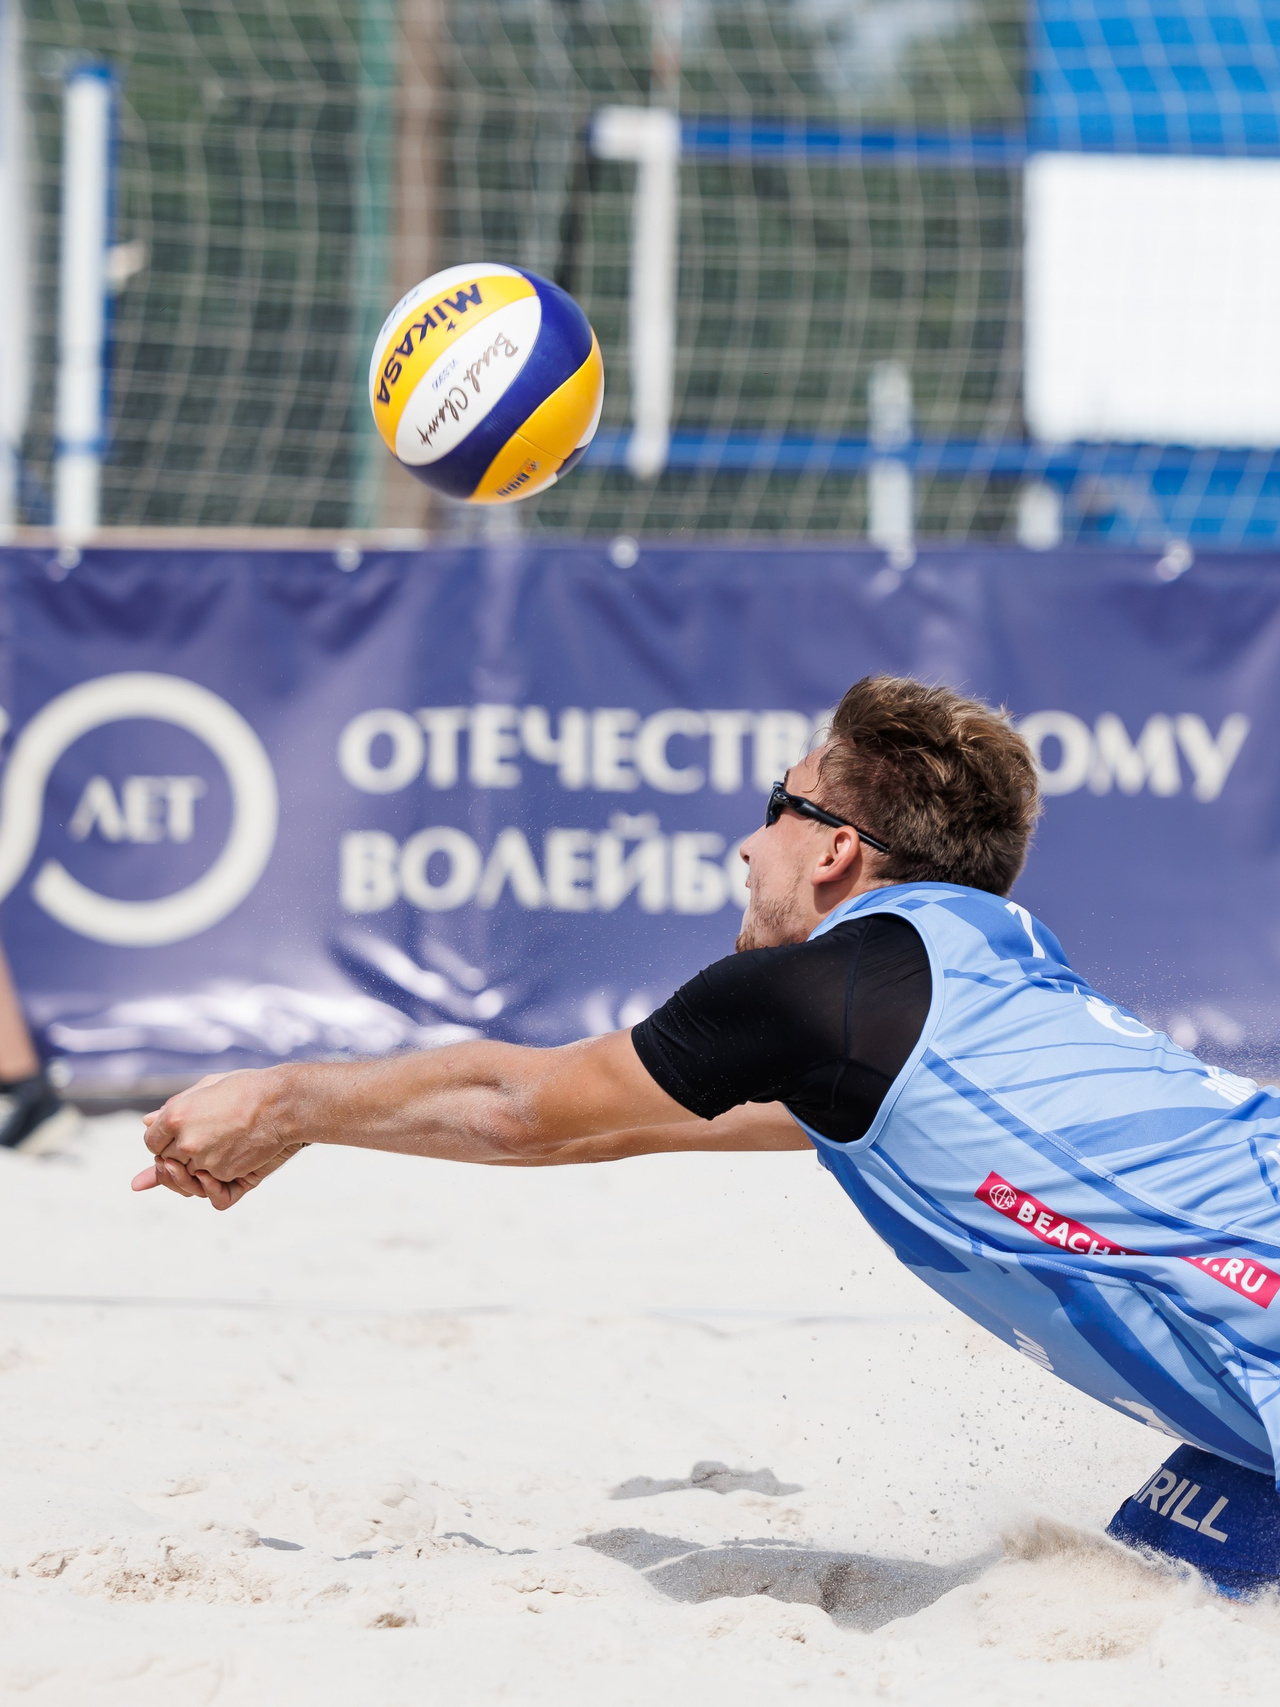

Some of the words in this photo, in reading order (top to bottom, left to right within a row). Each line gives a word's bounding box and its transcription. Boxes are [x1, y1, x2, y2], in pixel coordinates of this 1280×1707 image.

[376, 283, 483, 405] MIKASA
[464, 332, 519, 394] Beach
[338, 704, 1250, 801] ОТЕЧЕСТВОМУ
[69, 774, 207, 844] ЛЕТ
